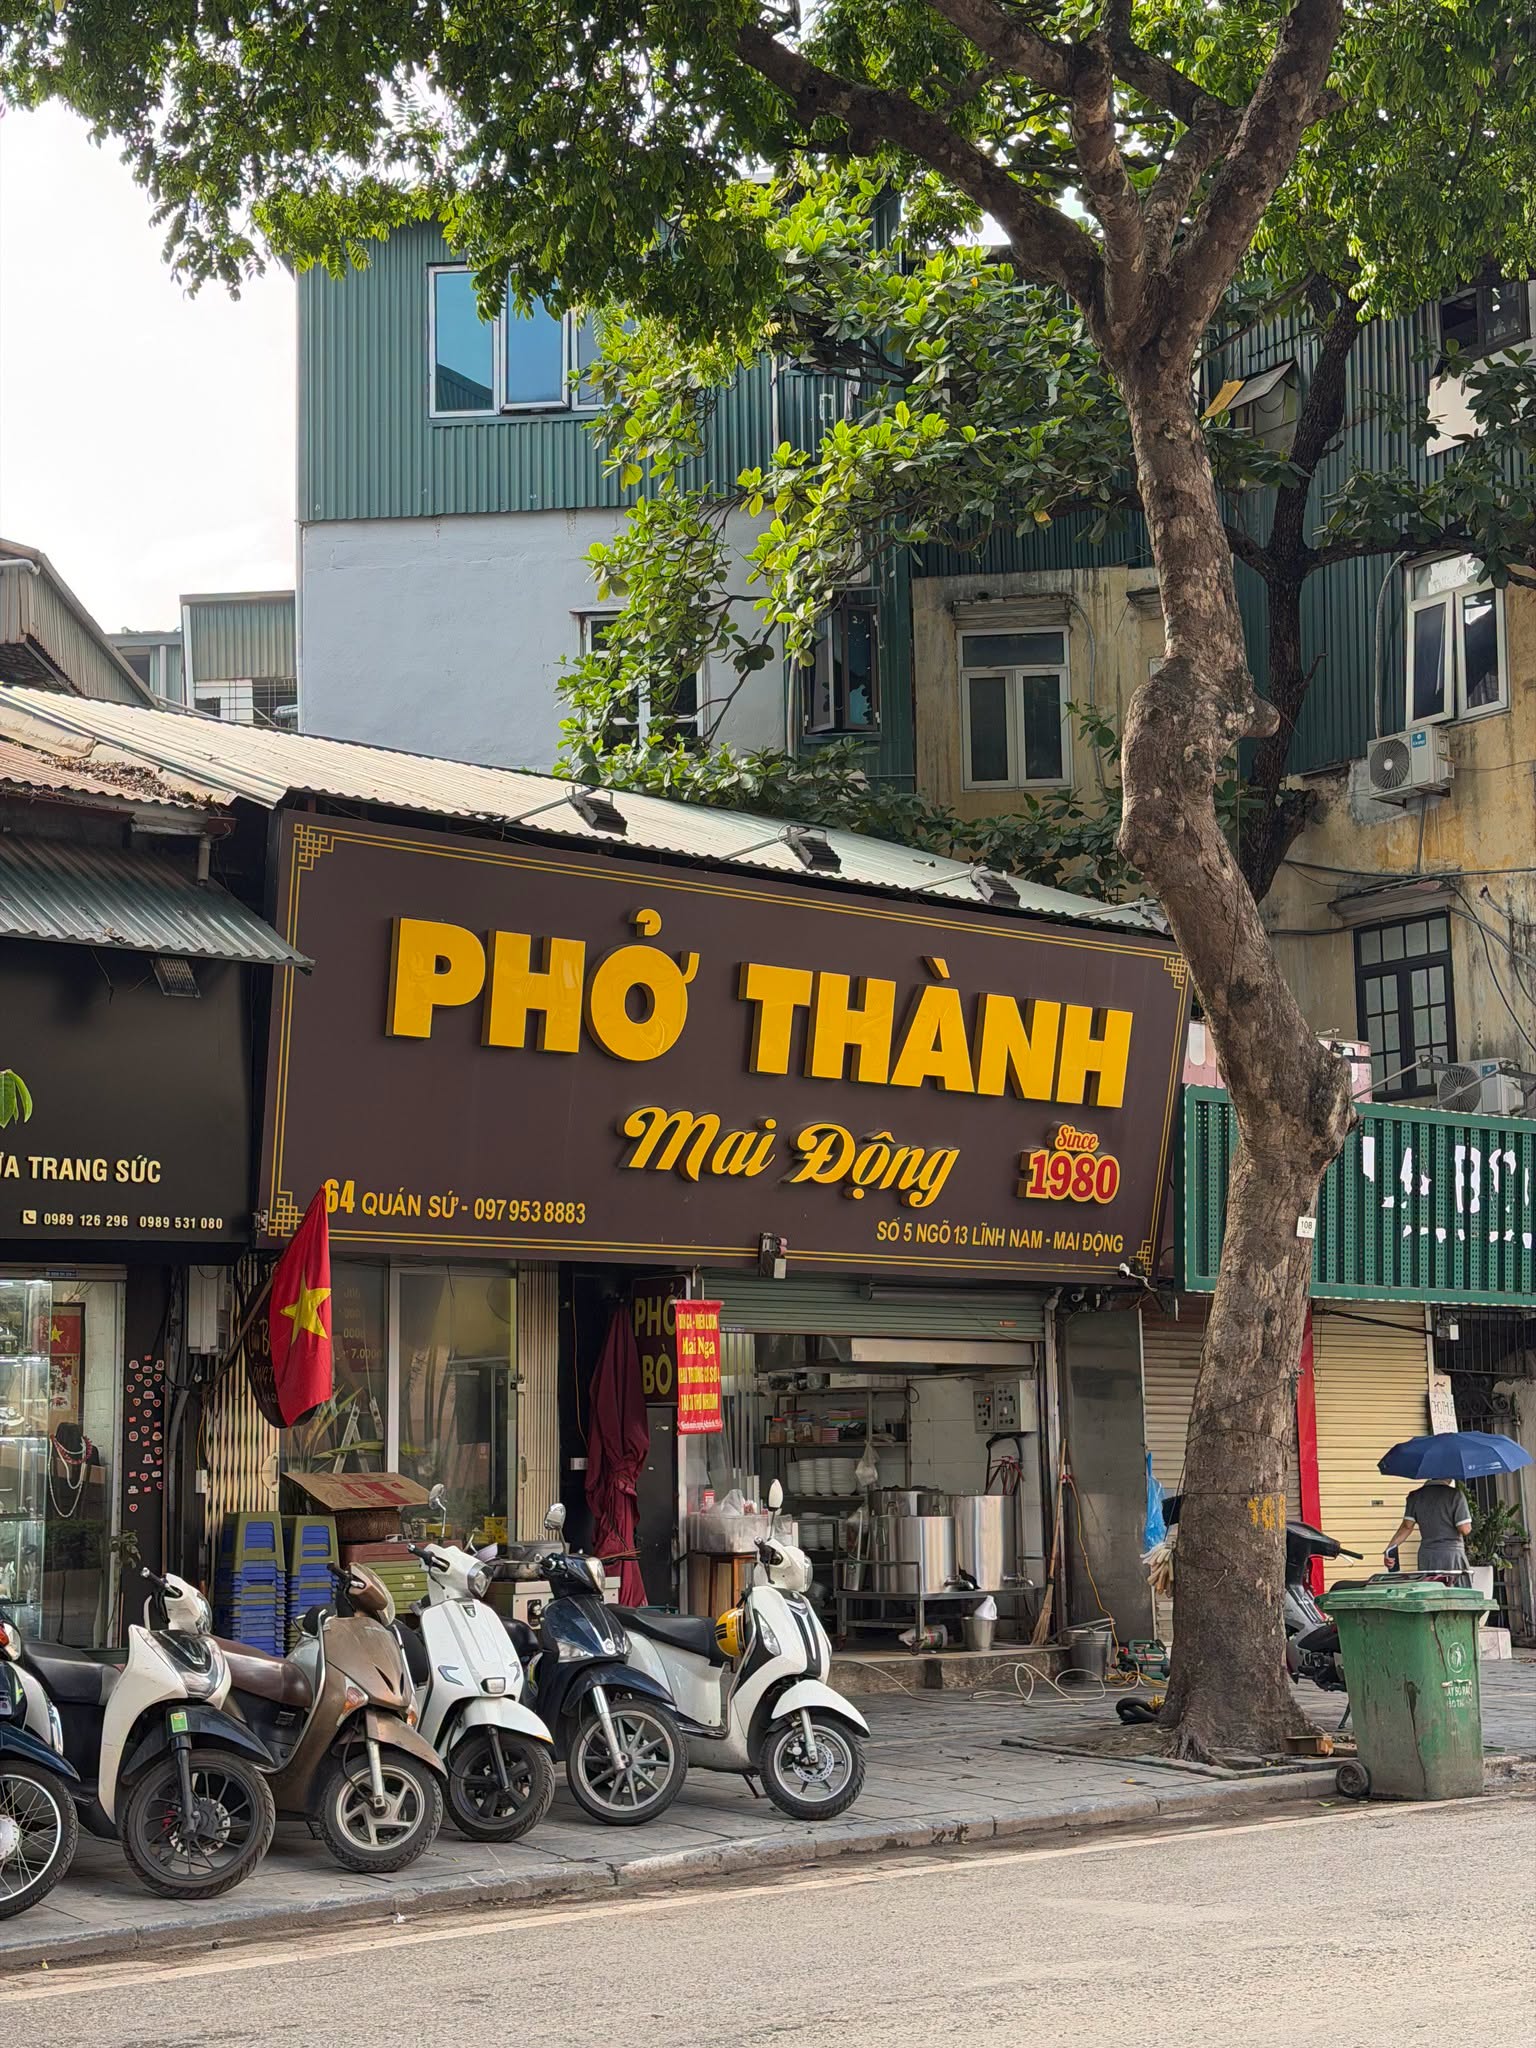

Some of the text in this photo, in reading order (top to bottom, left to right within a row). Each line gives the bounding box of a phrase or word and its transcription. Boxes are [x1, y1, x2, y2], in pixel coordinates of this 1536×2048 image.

[387, 908, 1134, 1108] PHỞ THÀNH
[620, 1105, 961, 1208] Mai Động
[1054, 1124, 1100, 1152] Since
[28, 1155, 108, 1182] TRANG
[115, 1154, 162, 1183] SỨC
[1025, 1149, 1121, 1204] 1980
[325, 1178, 355, 1214] 64
[361, 1187, 422, 1217] QUÁN
[427, 1190, 460, 1219] SỨ
[43, 1212, 224, 1230] 0989 126 296 0989 531 080
[876, 1218, 900, 1242] SỐ
[903, 1222, 913, 1243] 5
[916, 1219, 951, 1244] NGÕ
[953, 1224, 969, 1245] 13
[971, 1222, 1005, 1247] LĨNH
[1009, 1228, 1043, 1249] NAM
[1053, 1230, 1081, 1251] MAI
[1082, 1230, 1124, 1257] ĐỘNG
[1300, 1220, 1313, 1230] 108
[634, 1282, 682, 1337] PHỞ
[697, 1336, 716, 1360] Nga
[642, 1344, 673, 1395] BÒ
